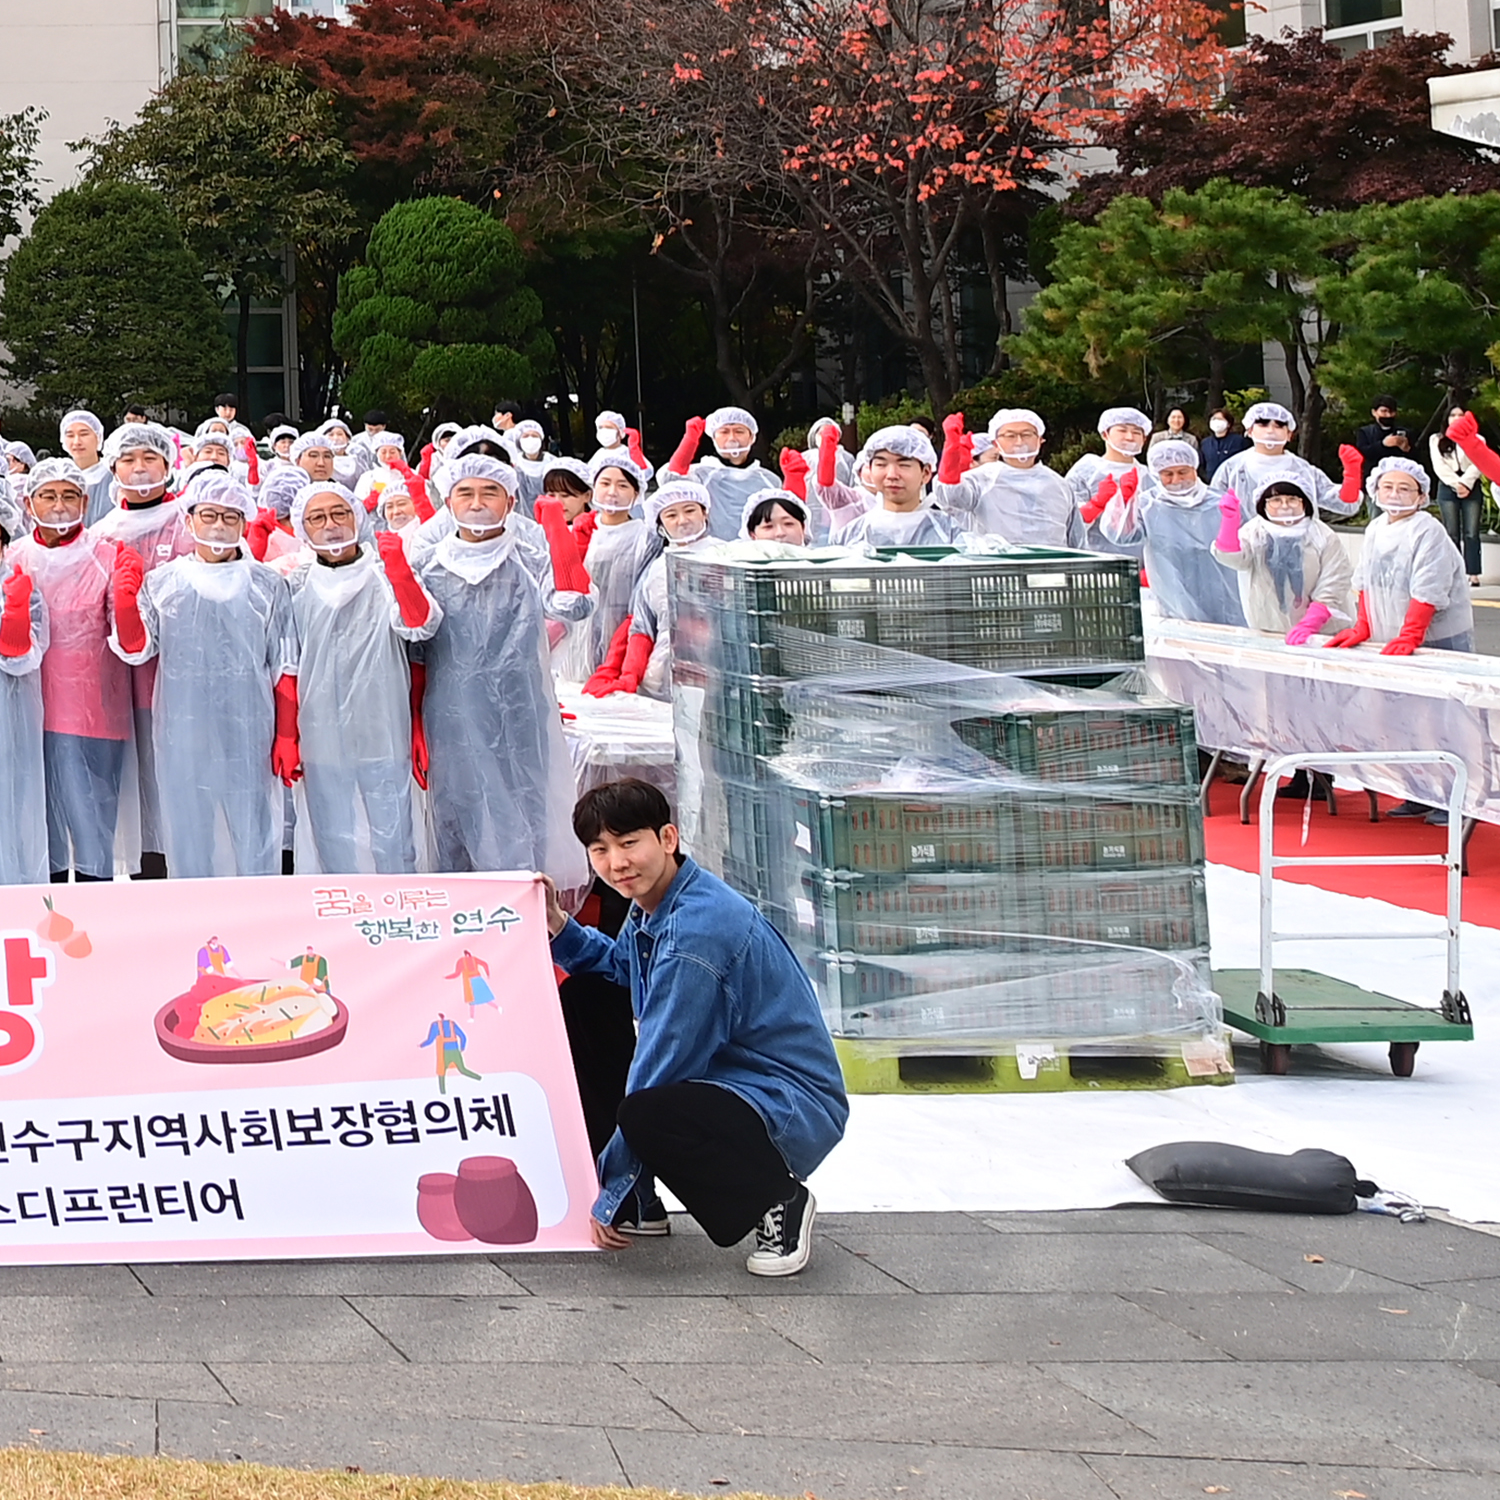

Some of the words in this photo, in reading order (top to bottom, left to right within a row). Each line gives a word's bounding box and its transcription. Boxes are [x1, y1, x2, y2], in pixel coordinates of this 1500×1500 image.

[314, 888, 373, 917] 꿈을
[383, 889, 448, 911] 이루는
[354, 916, 440, 946] 행복한
[452, 906, 521, 933] 연수
